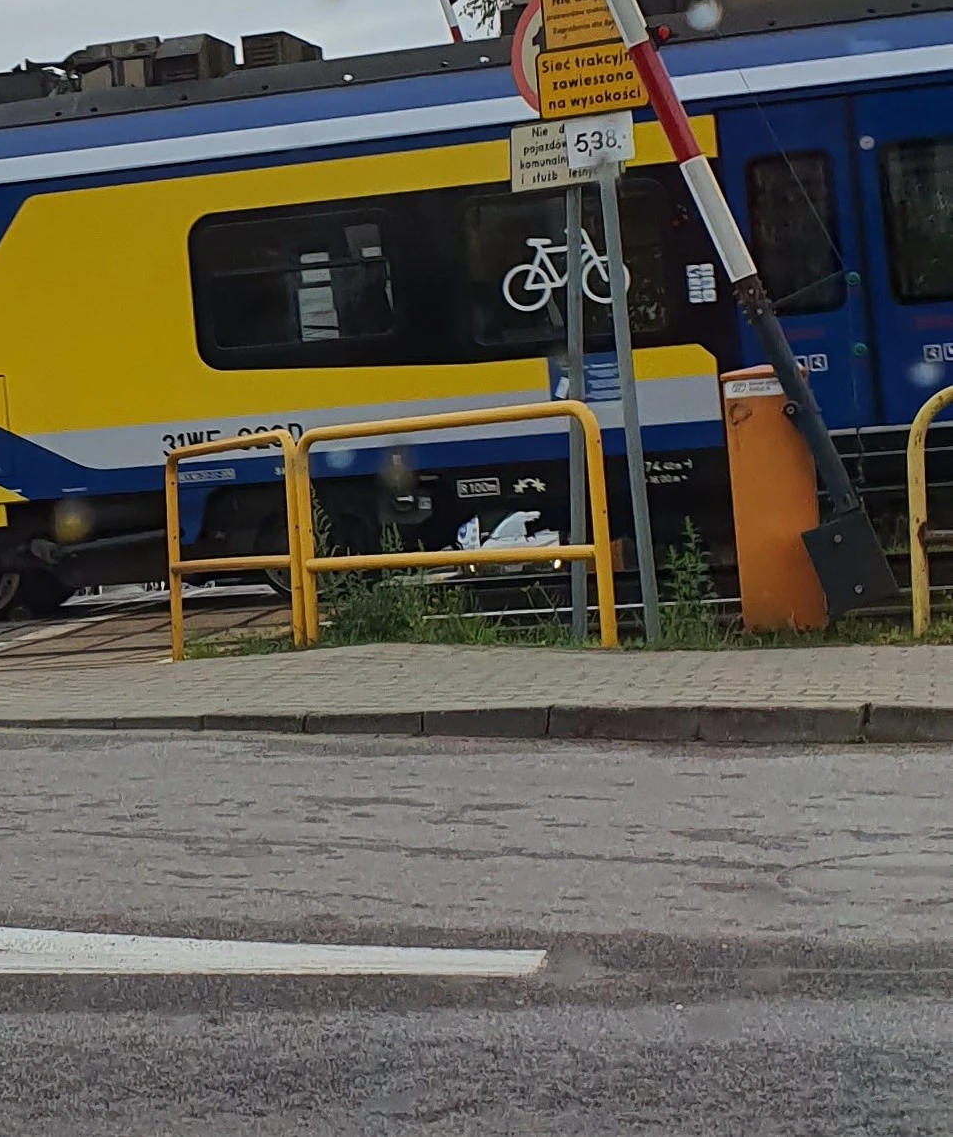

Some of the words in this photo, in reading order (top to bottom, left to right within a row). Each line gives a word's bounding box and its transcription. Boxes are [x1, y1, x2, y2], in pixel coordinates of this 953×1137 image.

[542, 57, 571, 73] Sieć
[575, 49, 632, 69] trakcyjn
[553, 71, 634, 91] zawieszona
[548, 99, 566, 110] na
[571, 85, 641, 109] wysokości
[531, 127, 548, 138] Nie
[558, 123, 565, 134] d
